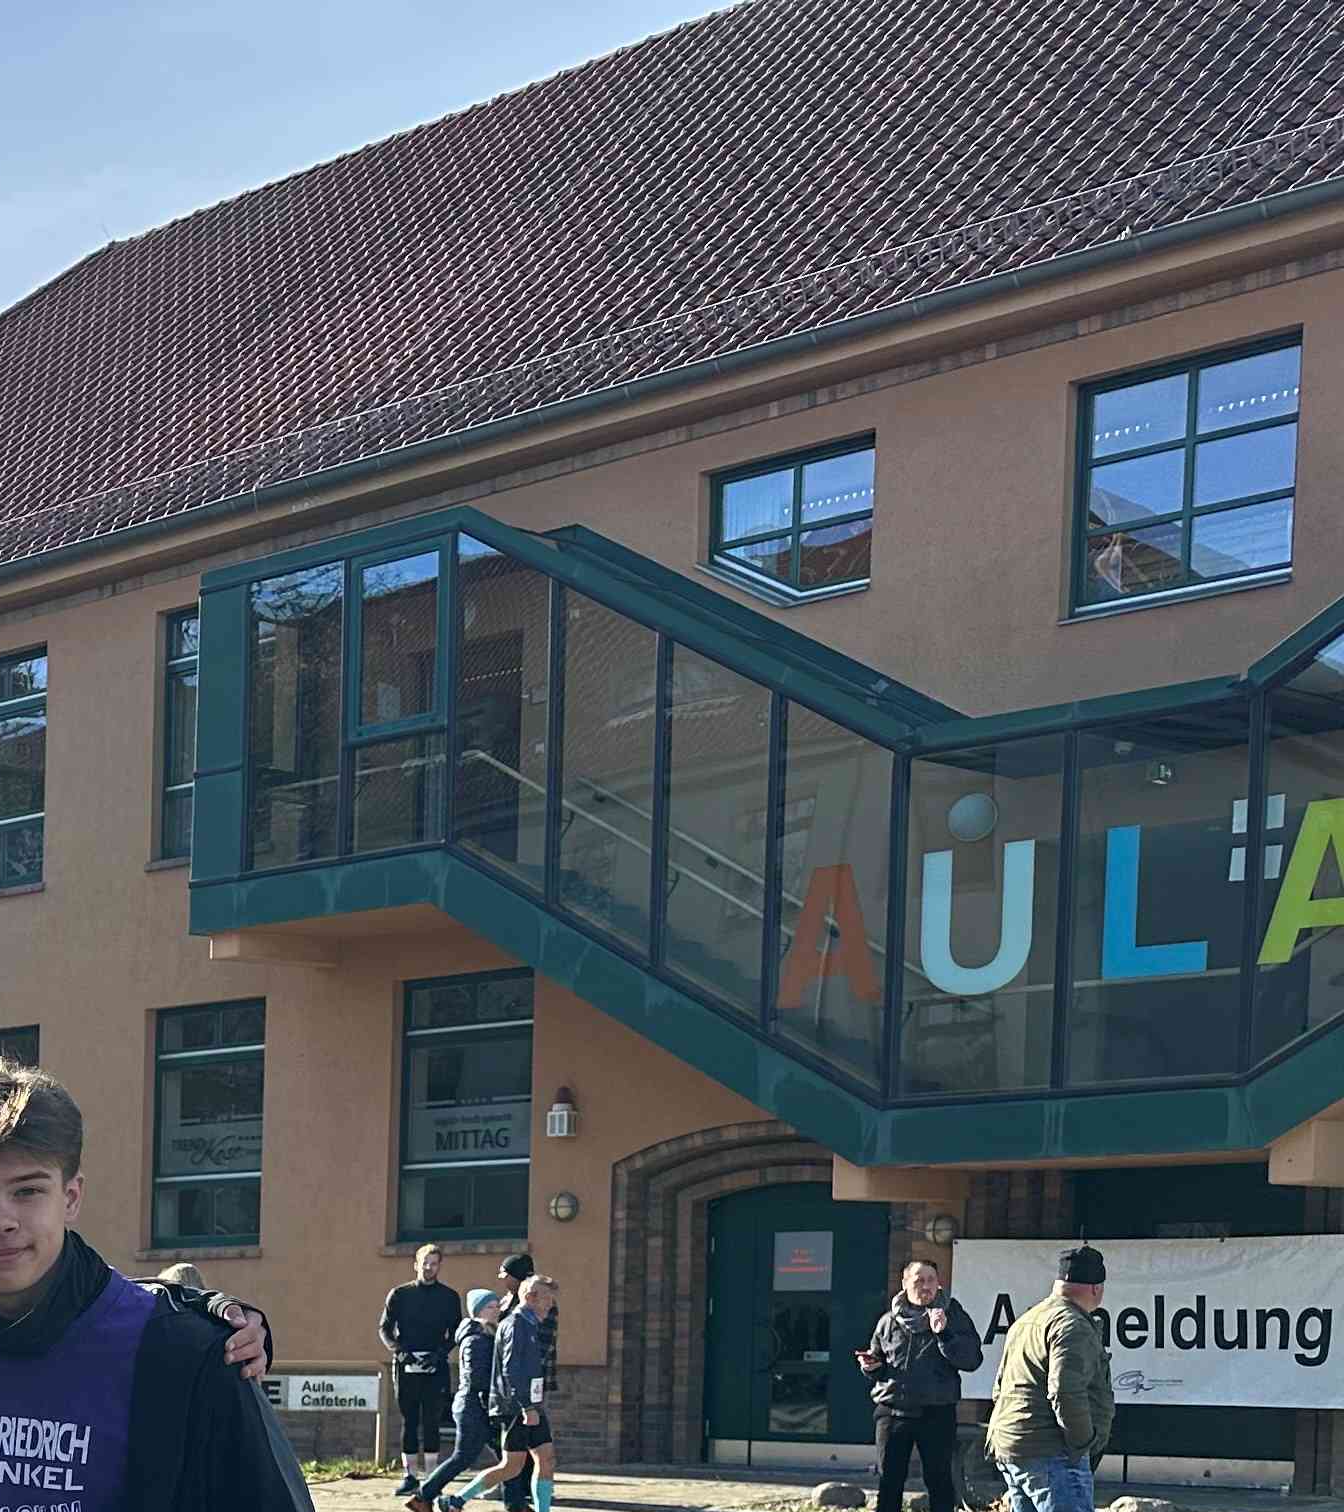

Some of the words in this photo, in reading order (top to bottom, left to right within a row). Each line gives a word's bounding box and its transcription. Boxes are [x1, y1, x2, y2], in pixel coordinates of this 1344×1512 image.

[435, 1127, 511, 1151] MITTAG
[983, 1292, 1333, 1367] Aeldung
[302, 1380, 335, 1393] Aula
[301, 1394, 367, 1407] Cafeteria
